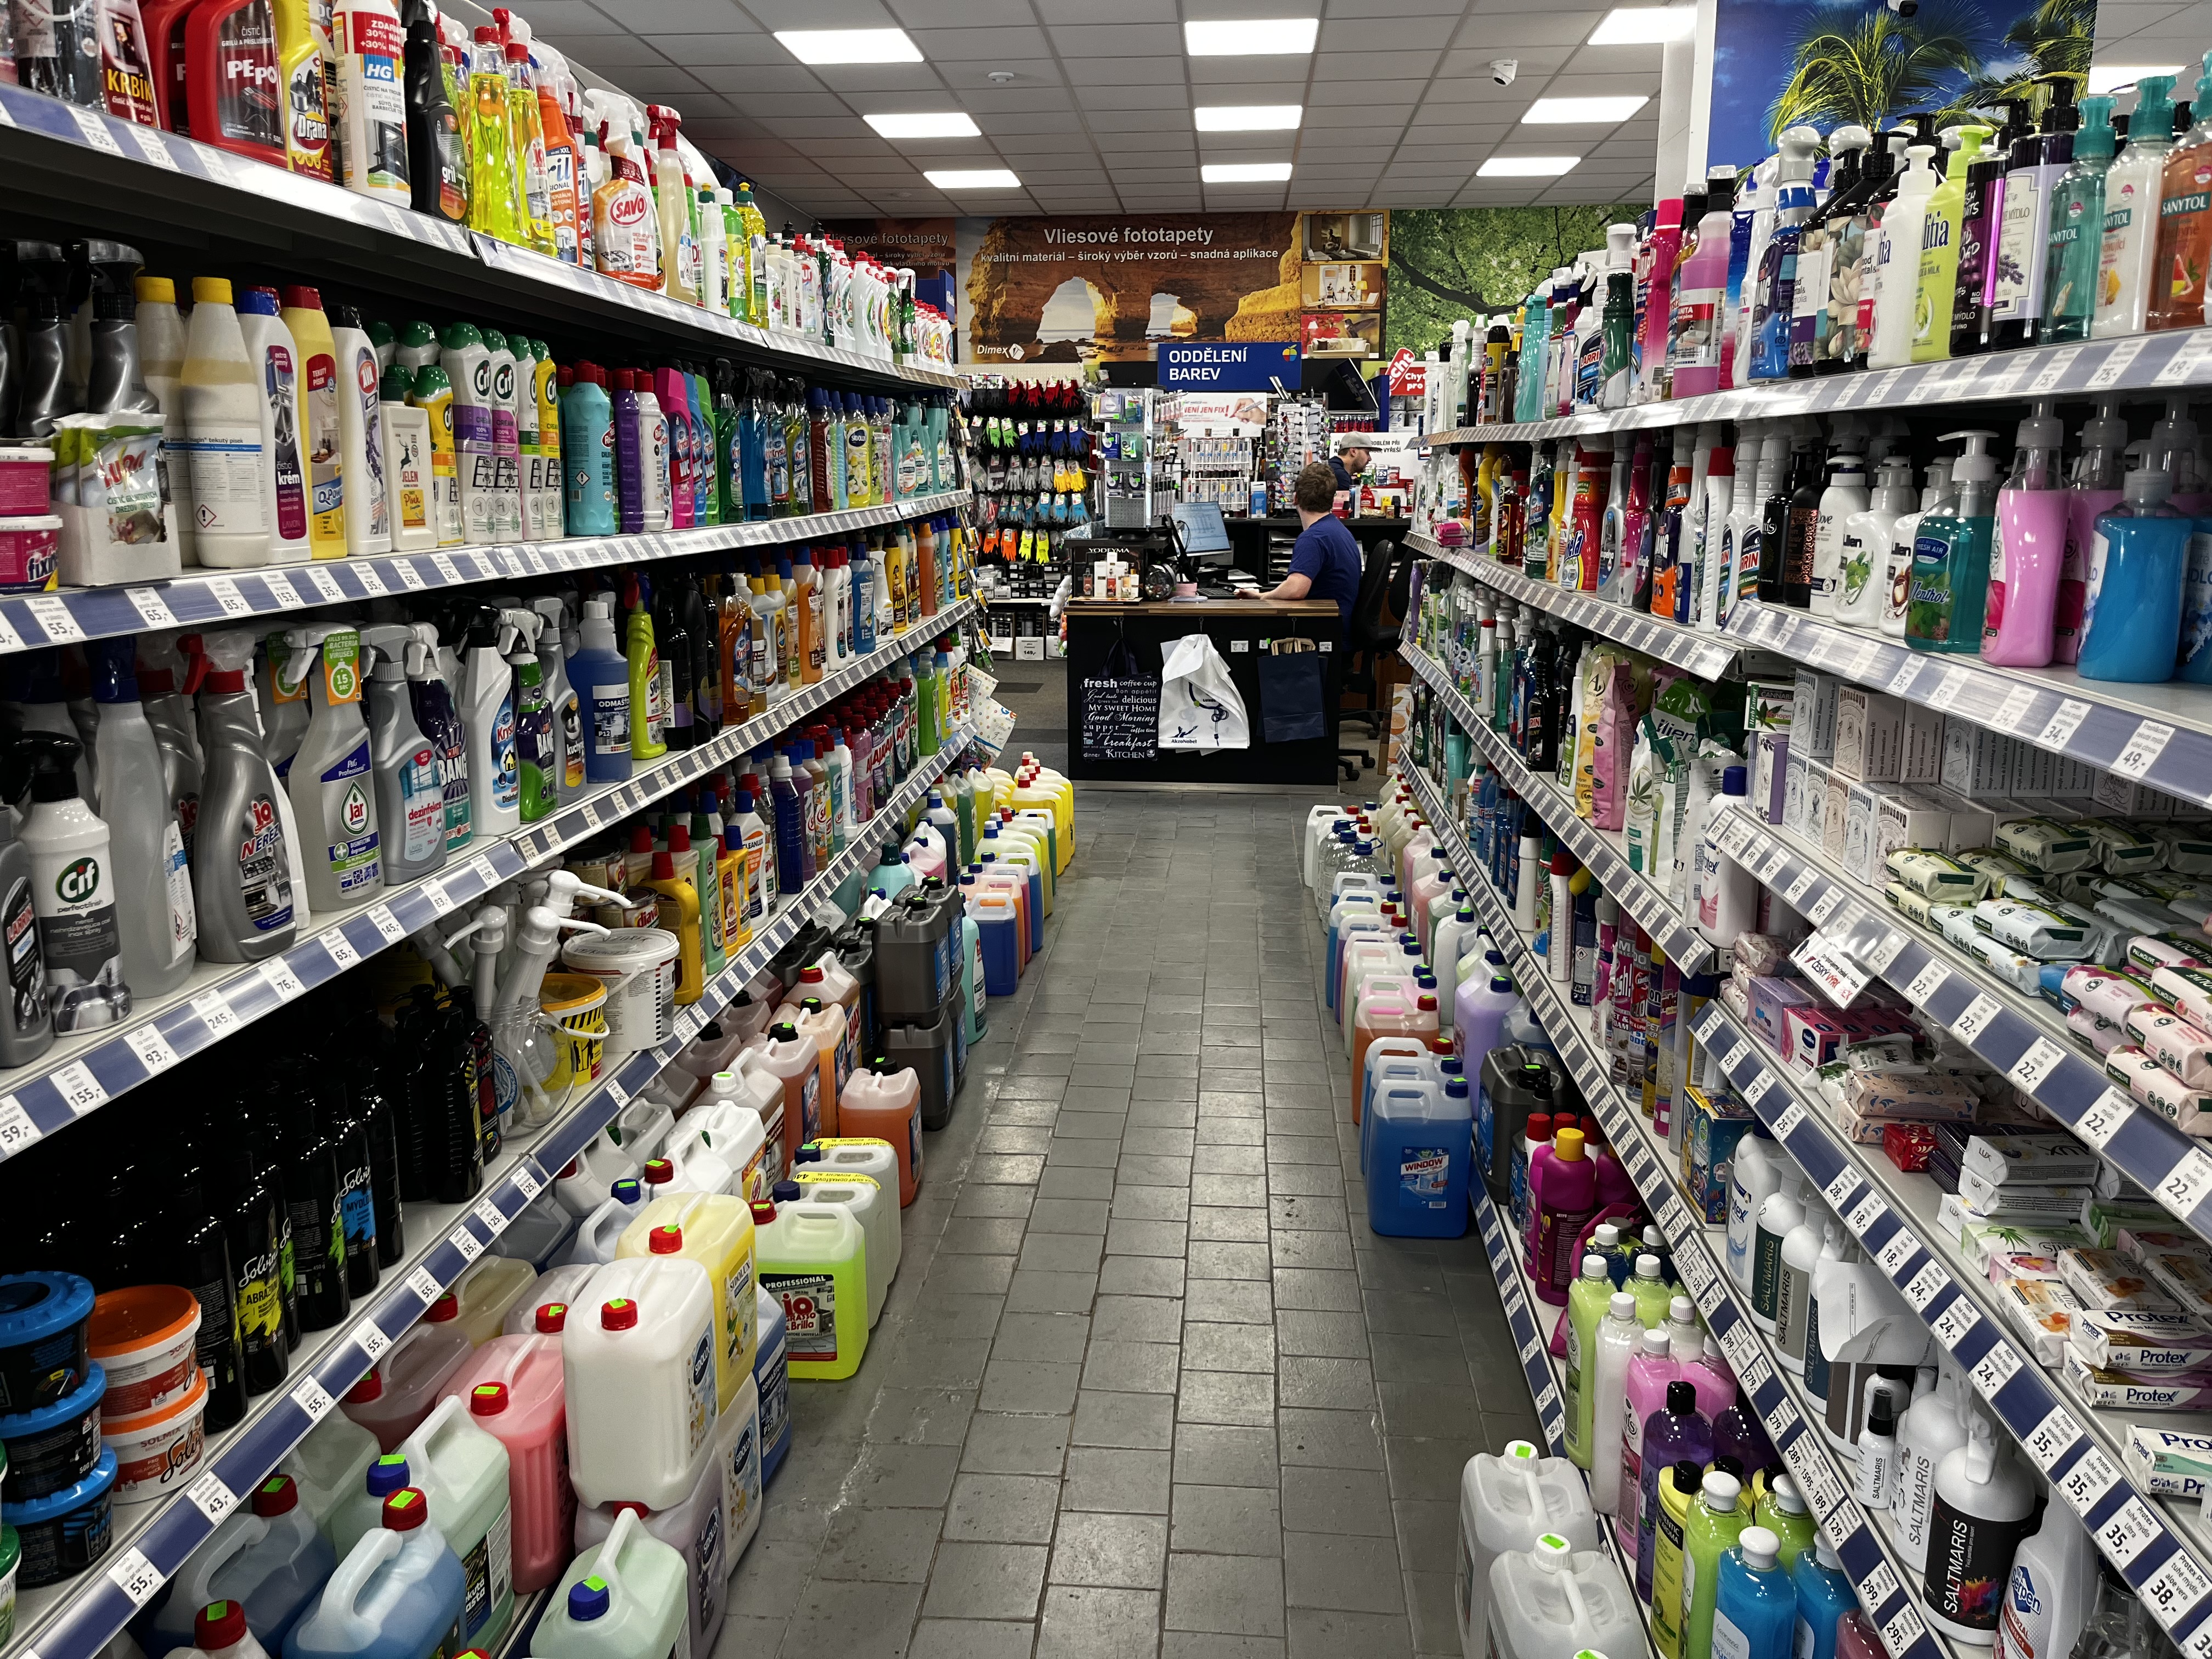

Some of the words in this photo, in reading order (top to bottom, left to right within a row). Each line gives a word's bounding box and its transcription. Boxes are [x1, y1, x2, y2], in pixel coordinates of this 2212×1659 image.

[241, 26, 261, 36] ČISTIČ
[366, 29, 386, 38] 30%
[360, 41, 386, 50] +30%
[366, 64, 392, 79] HG
[297, 114, 328, 140] Drana
[441, 166, 456, 186] gril
[614, 194, 645, 219] SAVO
[2162, 193, 2208, 216] SANYTOL
[882, 233, 949, 246] fototapety
[1044, 228, 1118, 244] Vliesové
[1124, 227, 1213, 244] fototapety
[981, 253, 1019, 262] kvalitní
[1022, 252, 1065, 262] materiál
[1078, 251, 1111, 262] široký
[1114, 250, 1144, 262] výběr
[1147, 249, 1177, 260] vzorů
[1190, 249, 1229, 259] snadná
[1233, 249, 1278, 260] aplikace
[977, 345, 1010, 358] Dimex
[1169, 347, 1247, 363] ODDĚLENÍ
[476, 365, 490, 391] Cif
[496, 369, 513, 393] Cif
[1169, 368, 1220, 380] BAREV
[402, 471, 418, 482] JELEN
[679, 460, 690, 477] WC
[277, 471, 300, 486] krém
[276, 591, 299, 604] 153,-
[1911, 580, 1949, 603] Menthol
[223, 599, 244, 611] 85,-
[894, 597, 905, 611] ALEX
[146, 608, 168, 622] 65,-
[48, 622, 75, 635] 55,-
[329, 640, 358, 648] BACTERIA
[330, 650, 353, 659] VIRUSES
[337, 674, 348, 684] 15
[1084, 679, 1117, 688] fresh
[1084, 712, 1113, 725] Good
[1114, 712, 1155, 725] Morning
[1104, 736, 1156, 751] breakfast
[2045, 726, 2065, 744] 34,-
[1106, 749, 1144, 758] KITCHEN
[2123, 752, 2145, 771] 49,-
[338, 764, 365, 777] Professional
[349, 801, 364, 822] Jar
[408, 801, 442, 820] dezinfekce
[240, 823, 279, 861] NEREZ
[62, 862, 95, 898] Cif
[336, 949, 352, 961] 65,-
[2132, 948, 2155, 964] PALMOLIVE
[277, 978, 296, 992] 76,-
[1911, 980, 1928, 998] 22,-
[2154, 987, 2176, 1004] PALMOLIVE
[207, 1012, 234, 1029] 245,-
[1957, 1016, 1977, 1036] 22,-
[145, 1050, 168, 1065] 93,-
[2017, 1061, 2038, 1084] 22,-
[2108, 1066, 2130, 1084] PALMOLIVE
[70, 1087, 101, 1107] 155,-
[1, 1125, 29, 1143] 59,-
[1776, 1120, 1789, 1135] 25,-
[2085, 1114, 2108, 1139] 22,-
[1978, 1147, 1992, 1161] LUX
[1405, 1158, 1443, 1171] WINDOW
[2165, 1177, 2192, 1204] 22,-
[730, 1261, 751, 1291] SIDOLUX
[766, 1275, 826, 1289] PROFESSIONAL
[1760, 1238, 1774, 1312] SALTMARIS
[1910, 1281, 1926, 1302] 24,-
[1779, 1269, 1791, 1345] SALTMARIS
[791, 1320, 814, 1330] Brilla
[2104, 1311, 2192, 1324] Protex
[368, 1337, 383, 1354] 55,-
[695, 1344, 710, 1377] SIDOLUX
[2140, 1349, 2192, 1364] Protex
[1977, 1364, 1996, 1387] 24,-
[2126, 1388, 2180, 1403] Protex
[2051, 1416, 2061, 1428] tuhé
[2059, 1427, 2072, 1442] mýdlo
[2061, 1414, 2075, 1431] Protex
[140, 1426, 182, 1448] SOLMIX
[2033, 1431, 2053, 1458] 35,-
[2046, 1426, 2063, 1447] sensitive
[208, 1494, 229, 1514] 43,-
[2137, 1505, 2153, 1526] Protex
[2106, 1524, 2130, 1554] 35,-
[2124, 1523, 2136, 1538] Ultra
[1944, 1520, 1967, 1613] SALTMARIS
[2179, 1554, 2197, 1576] Protex
[2195, 1576, 2207, 1588] Pro
[130, 1571, 155, 1595] 55,-
[2165, 1573, 2176, 1589] aloe
[2175, 1587, 2188, 1601] vera
[2170, 1562, 2182, 1576] tuhé
[2181, 1577, 2198, 1596] mýdlo
[1862, 1579, 1878, 1609] 299,-
[2012, 1567, 2042, 1615] Serpen
[2150, 1579, 2177, 1613] 38,-
[1887, 1622, 1904, 1651] 295,-
